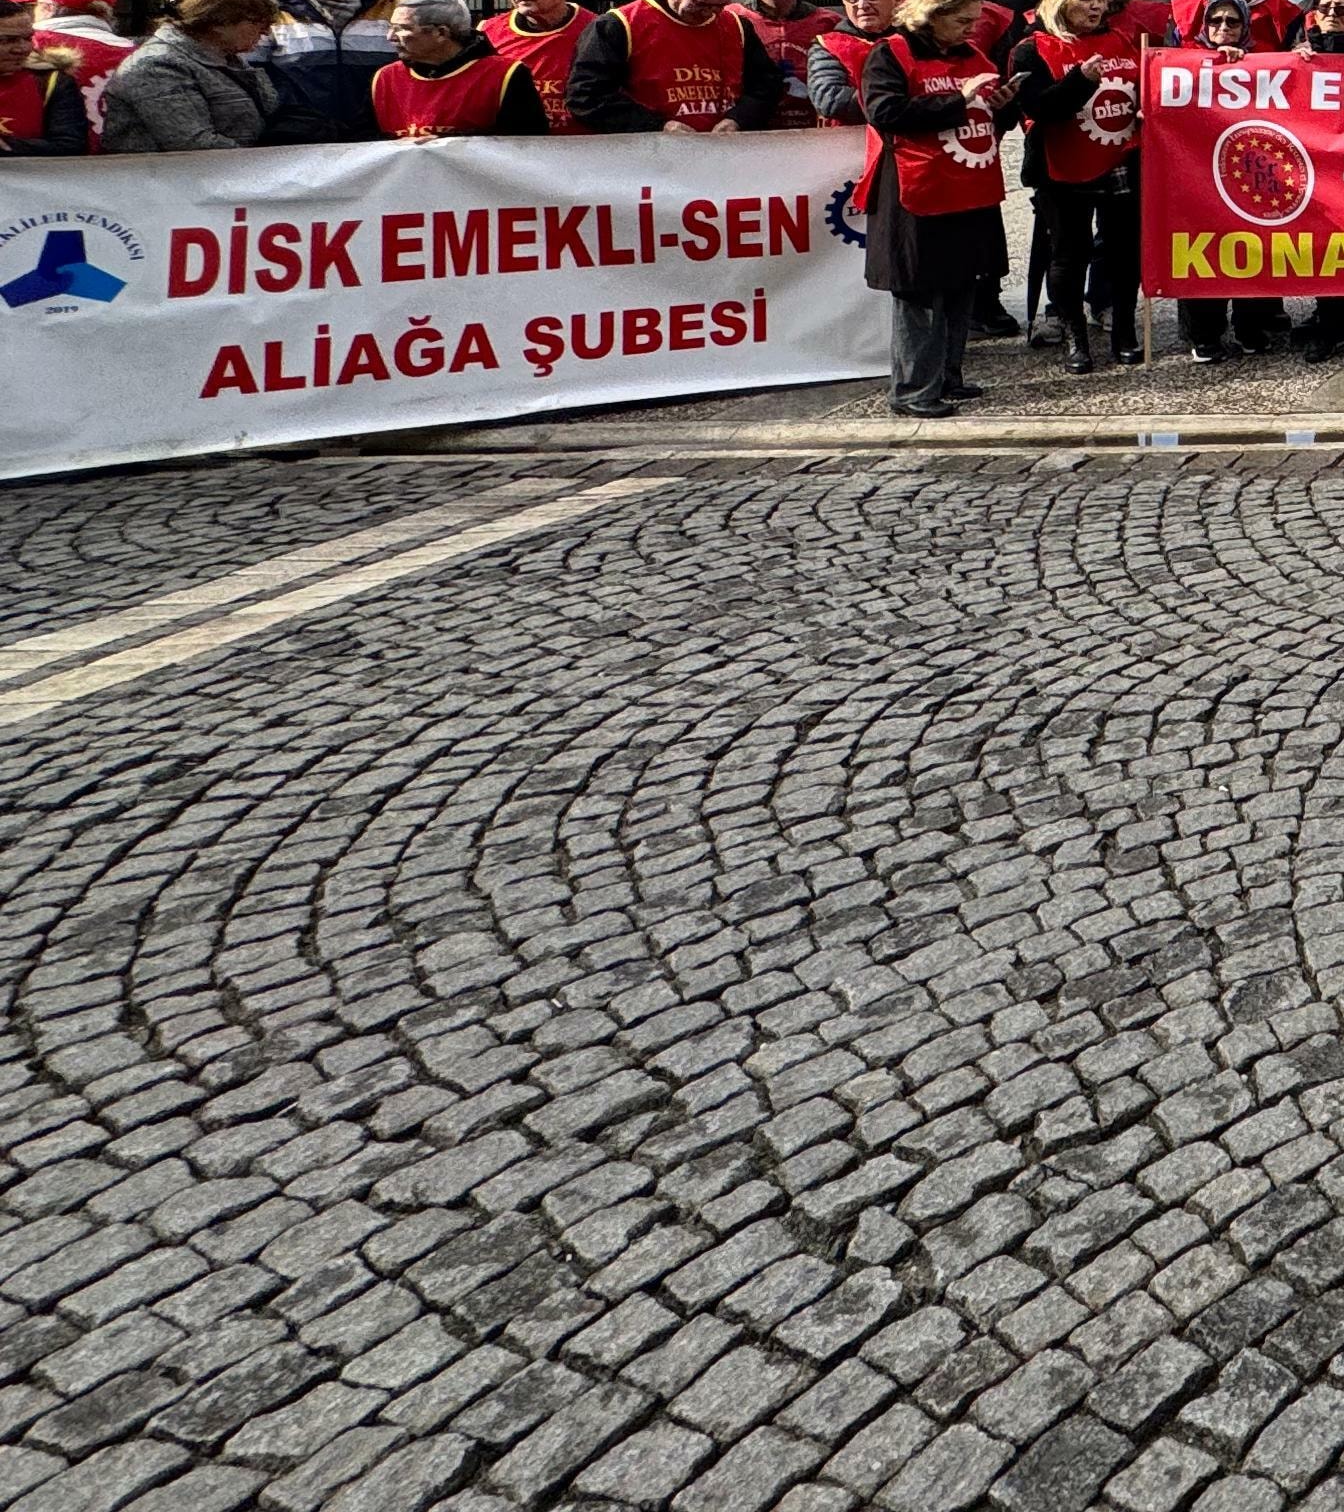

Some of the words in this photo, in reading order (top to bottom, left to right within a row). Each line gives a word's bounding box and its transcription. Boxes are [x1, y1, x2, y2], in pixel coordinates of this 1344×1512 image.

[1094, 99, 1134, 120] DİSK
[1160, 58, 1292, 110] DİSK
[167, 207, 362, 299] DİSK
[380, 186, 811, 284] EMEKLİ-SEN
[200, 313, 499, 398] ALİAĞA
[521, 288, 768, 377] ŞUBESİ
